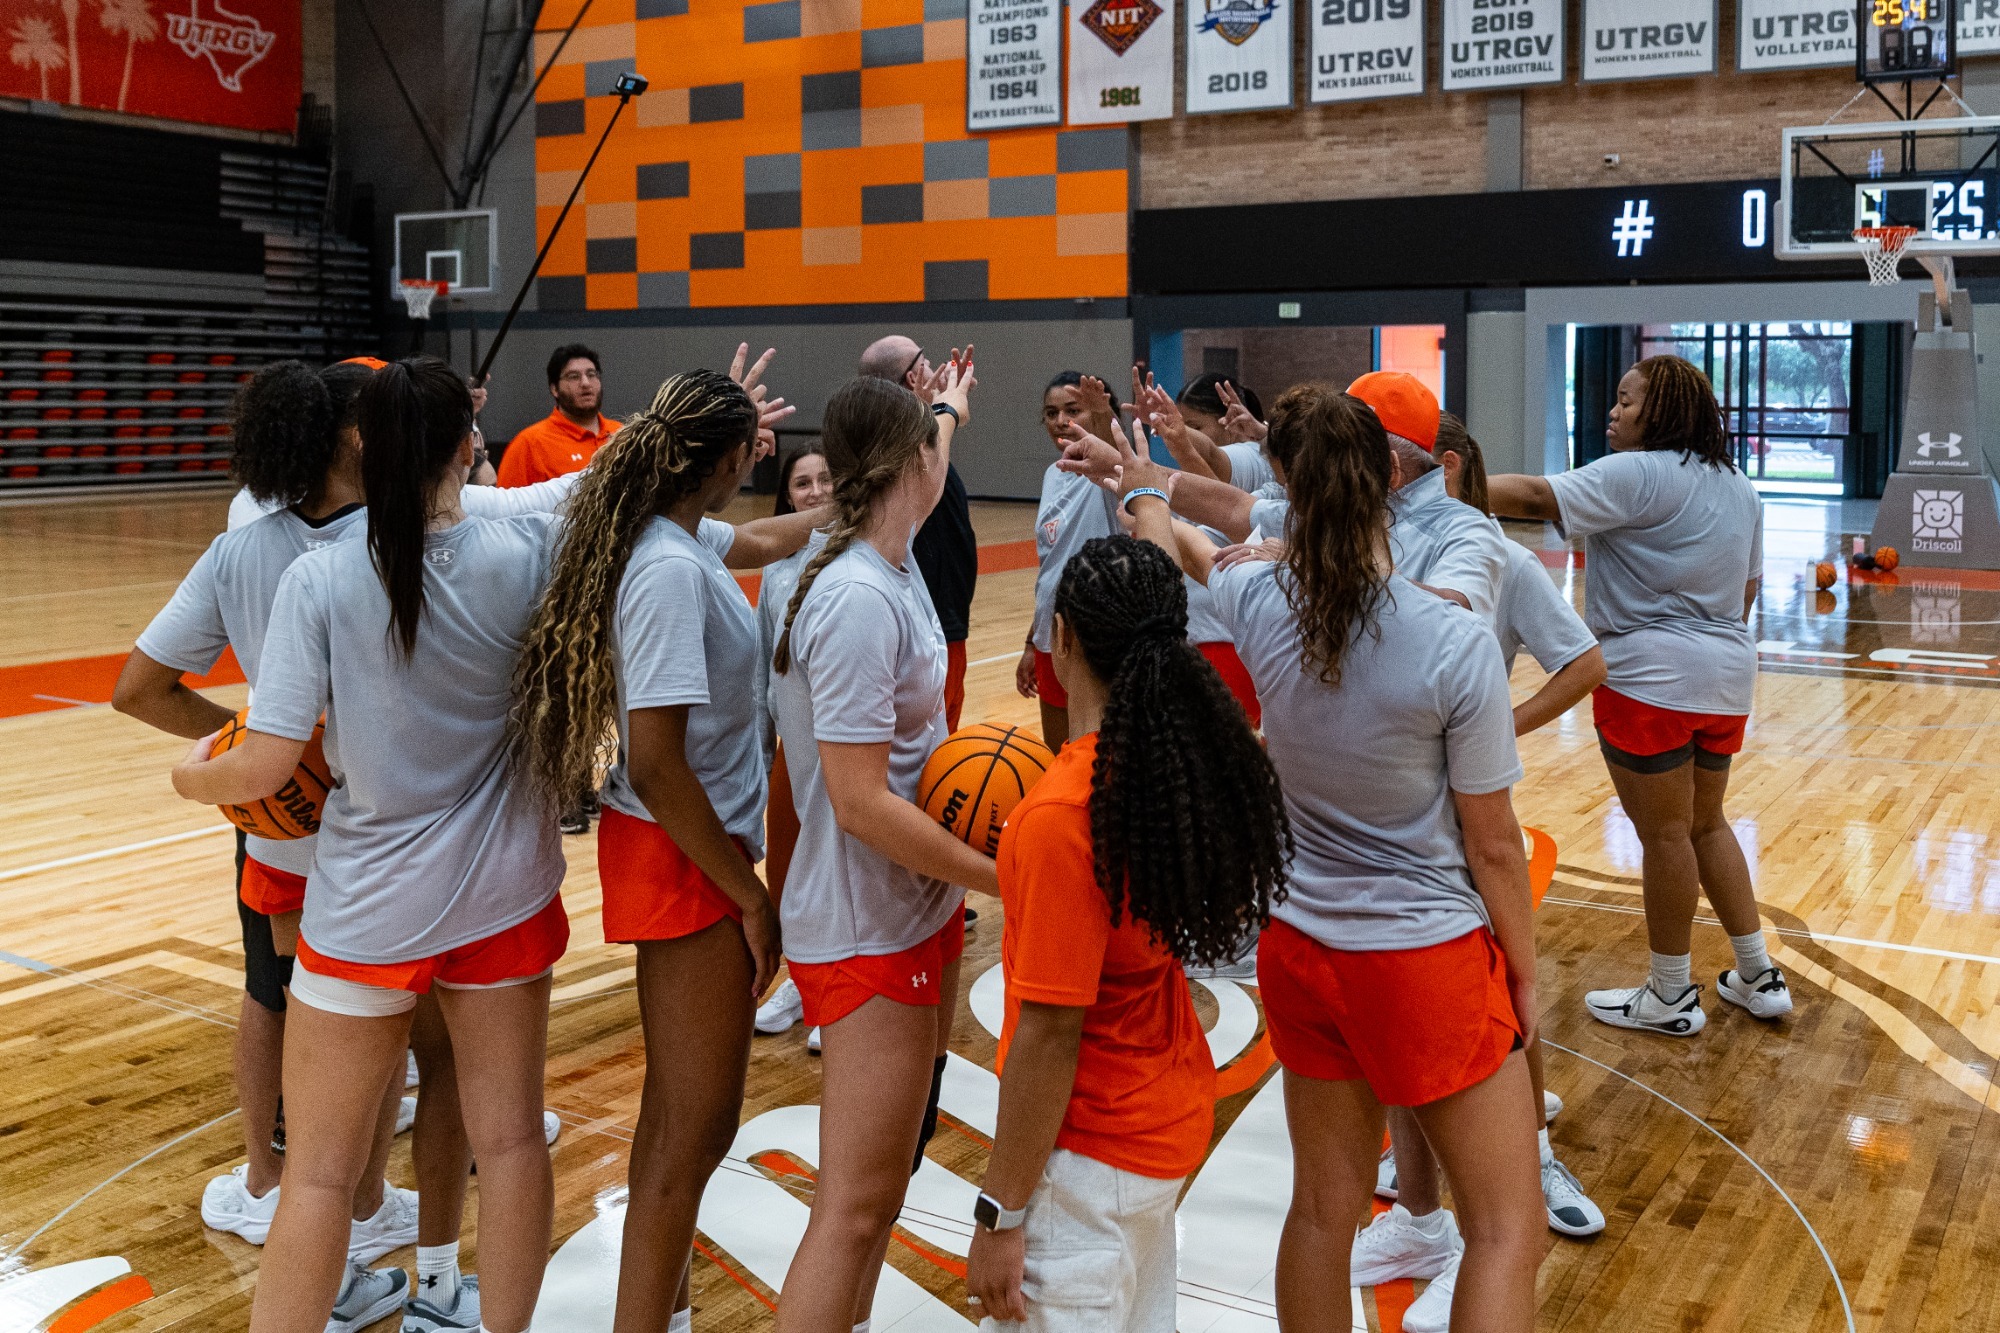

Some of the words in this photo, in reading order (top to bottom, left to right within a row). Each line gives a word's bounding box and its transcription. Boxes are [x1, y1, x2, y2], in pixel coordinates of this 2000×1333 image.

[979, 7, 1048, 24] CHAMPIONS
[1101, 7, 1144, 27] NIT
[1322, 0, 1410, 25] 2019
[1471, 11, 1533, 34] 2019
[166, 14, 275, 57] UTRGV
[990, 24, 1037, 45] 1963
[1595, 21, 1707, 51] UTRGV
[984, 50, 1042, 65] NATIONAL
[1451, 34, 1554, 63] UTRGV
[1595, 54, 1637, 63] WOMEN'S
[1639, 49, 1702, 61] BASKETBALL
[1755, 38, 1857, 57] VOLLEYBAL
[1318, 46, 1413, 74] UTRGV
[1451, 66, 1491, 79] WOMEN'S
[1494, 61, 1554, 76] BASKETBALL
[979, 63, 1046, 79] RUNNER-UP
[1318, 78, 1347, 90] MEN'S
[1350, 72, 1414, 87] BASKETBALL
[990, 80, 1037, 101] 1964
[1208, 70, 1268, 93] 2018
[1000, 104, 1055, 117] BASKETBALL
[1912, 538, 1962, 551] Driscoll
